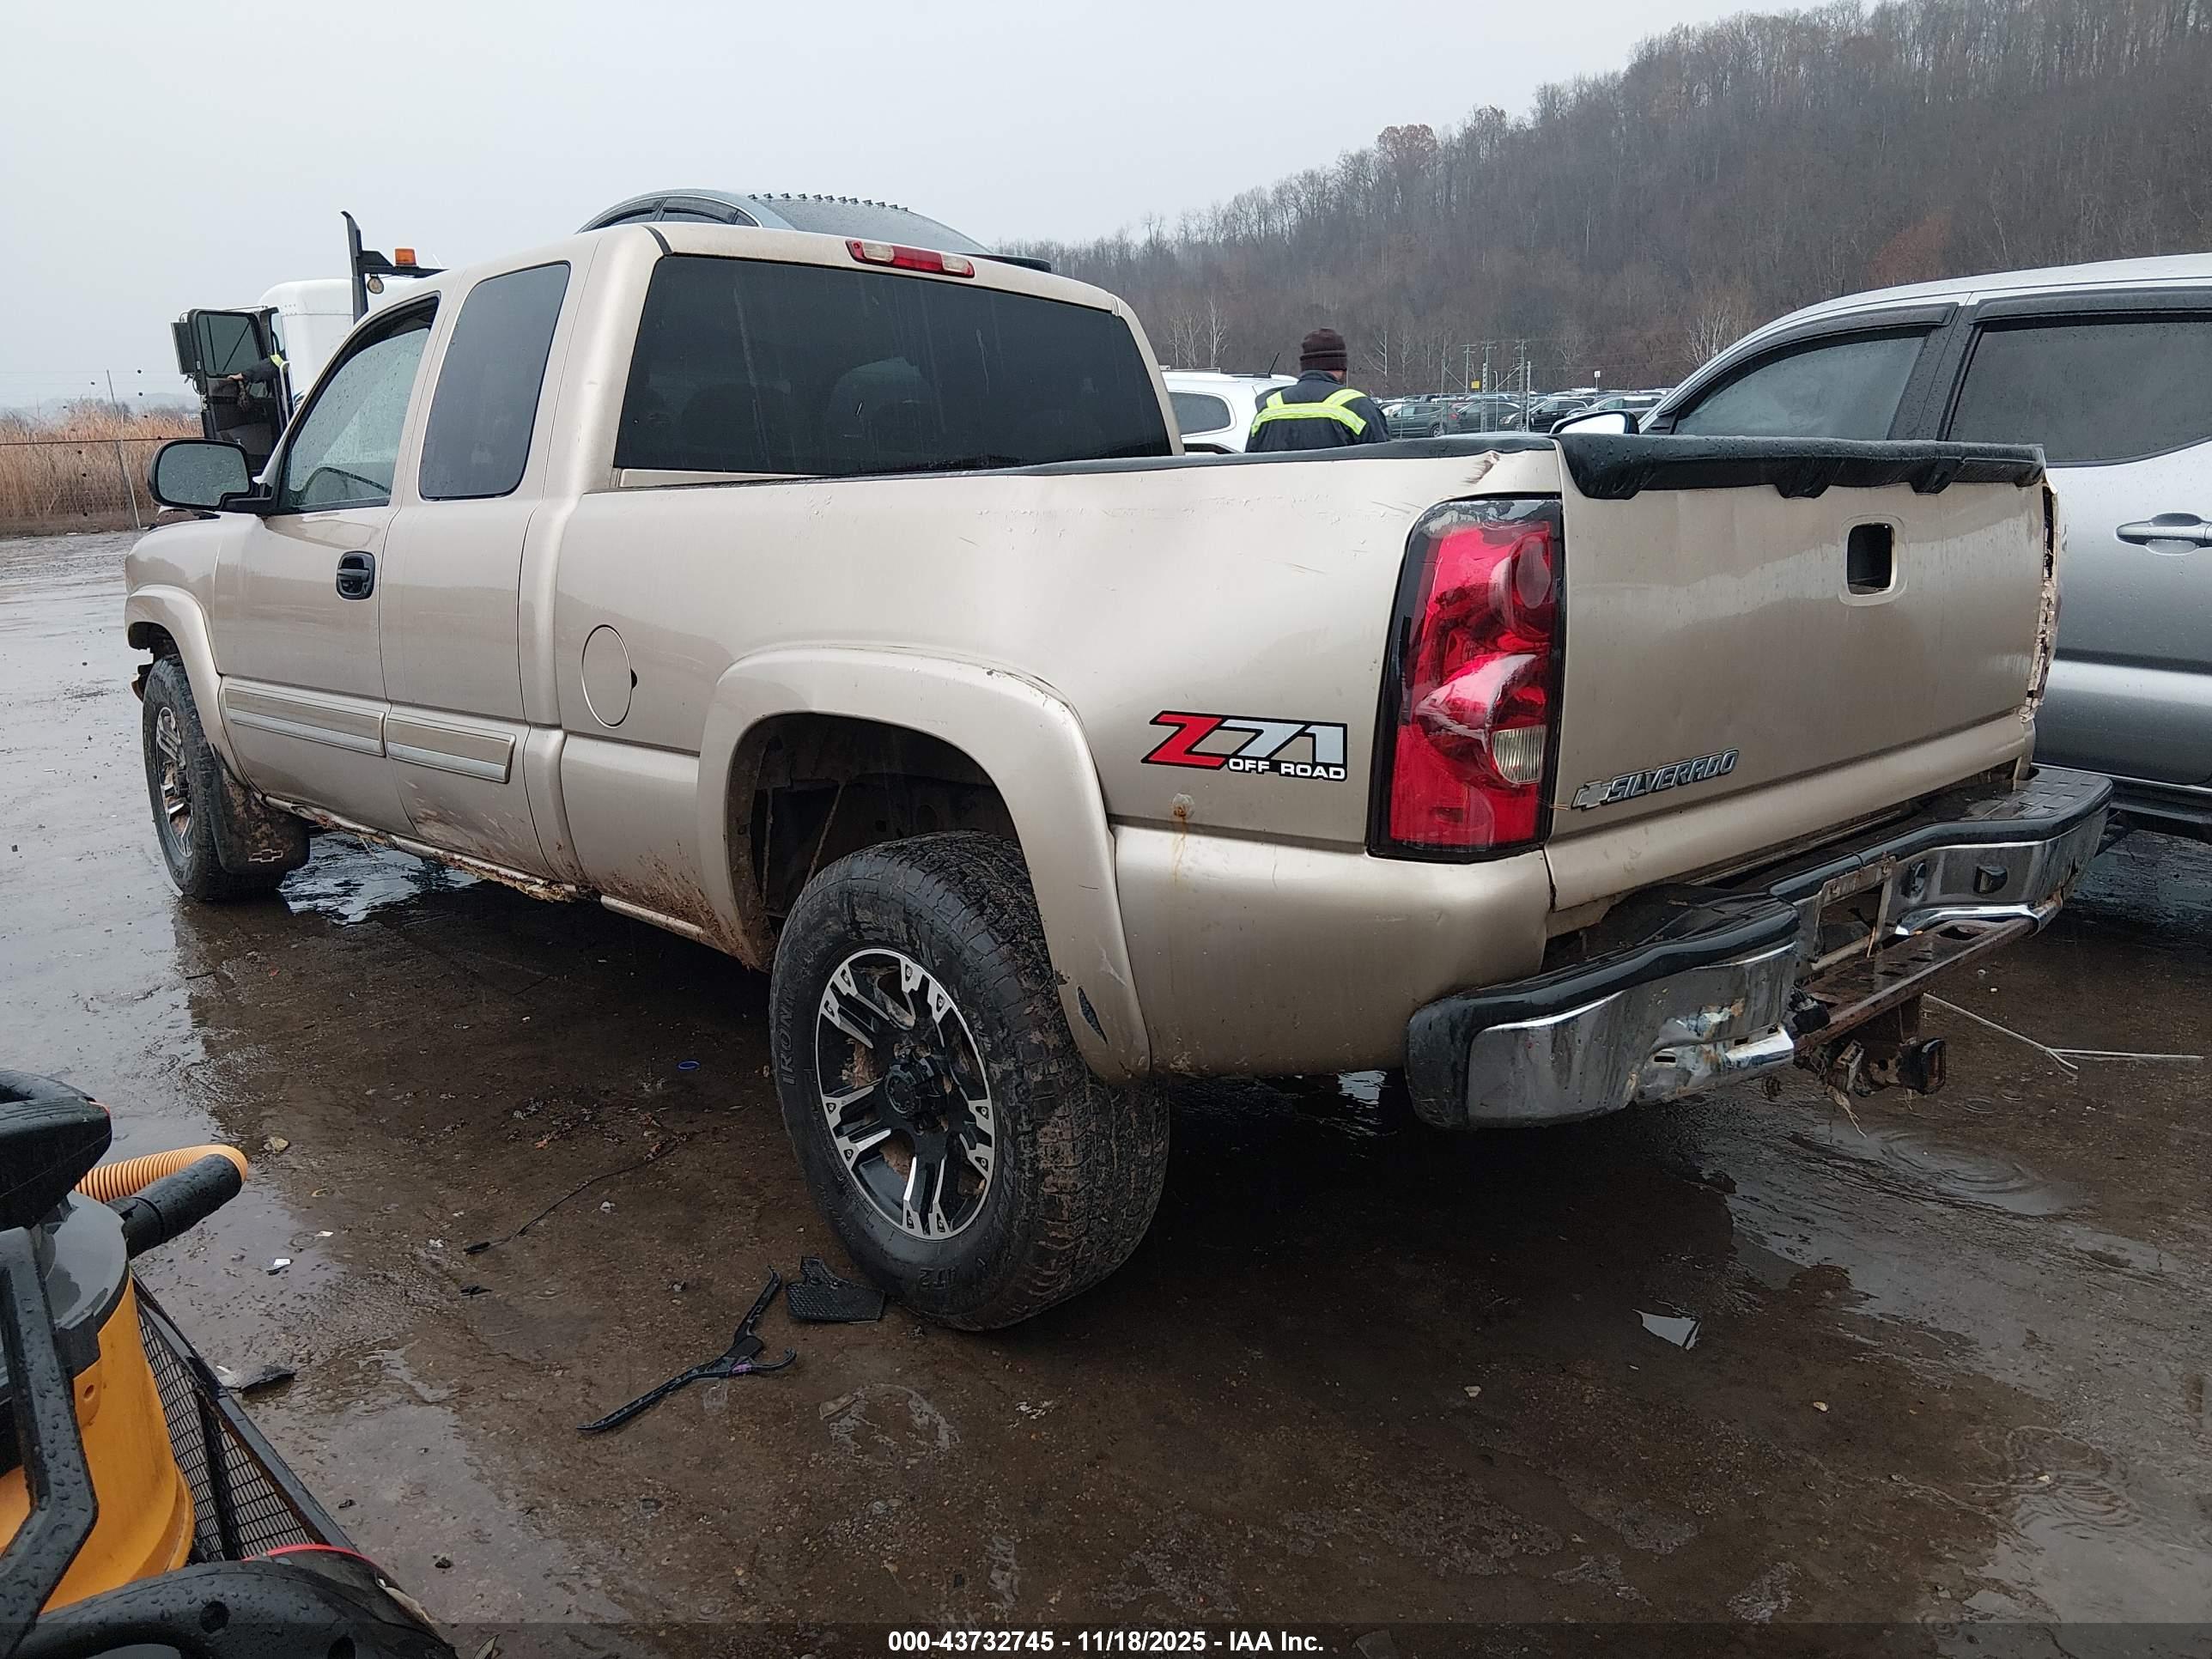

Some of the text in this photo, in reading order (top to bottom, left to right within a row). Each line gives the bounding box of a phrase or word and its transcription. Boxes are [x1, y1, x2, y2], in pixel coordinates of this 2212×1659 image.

[1141, 710, 1347, 771] Z71
[1228, 758, 1346, 780] OFF ROAD
[1607, 748, 1740, 803] SILVERADO
